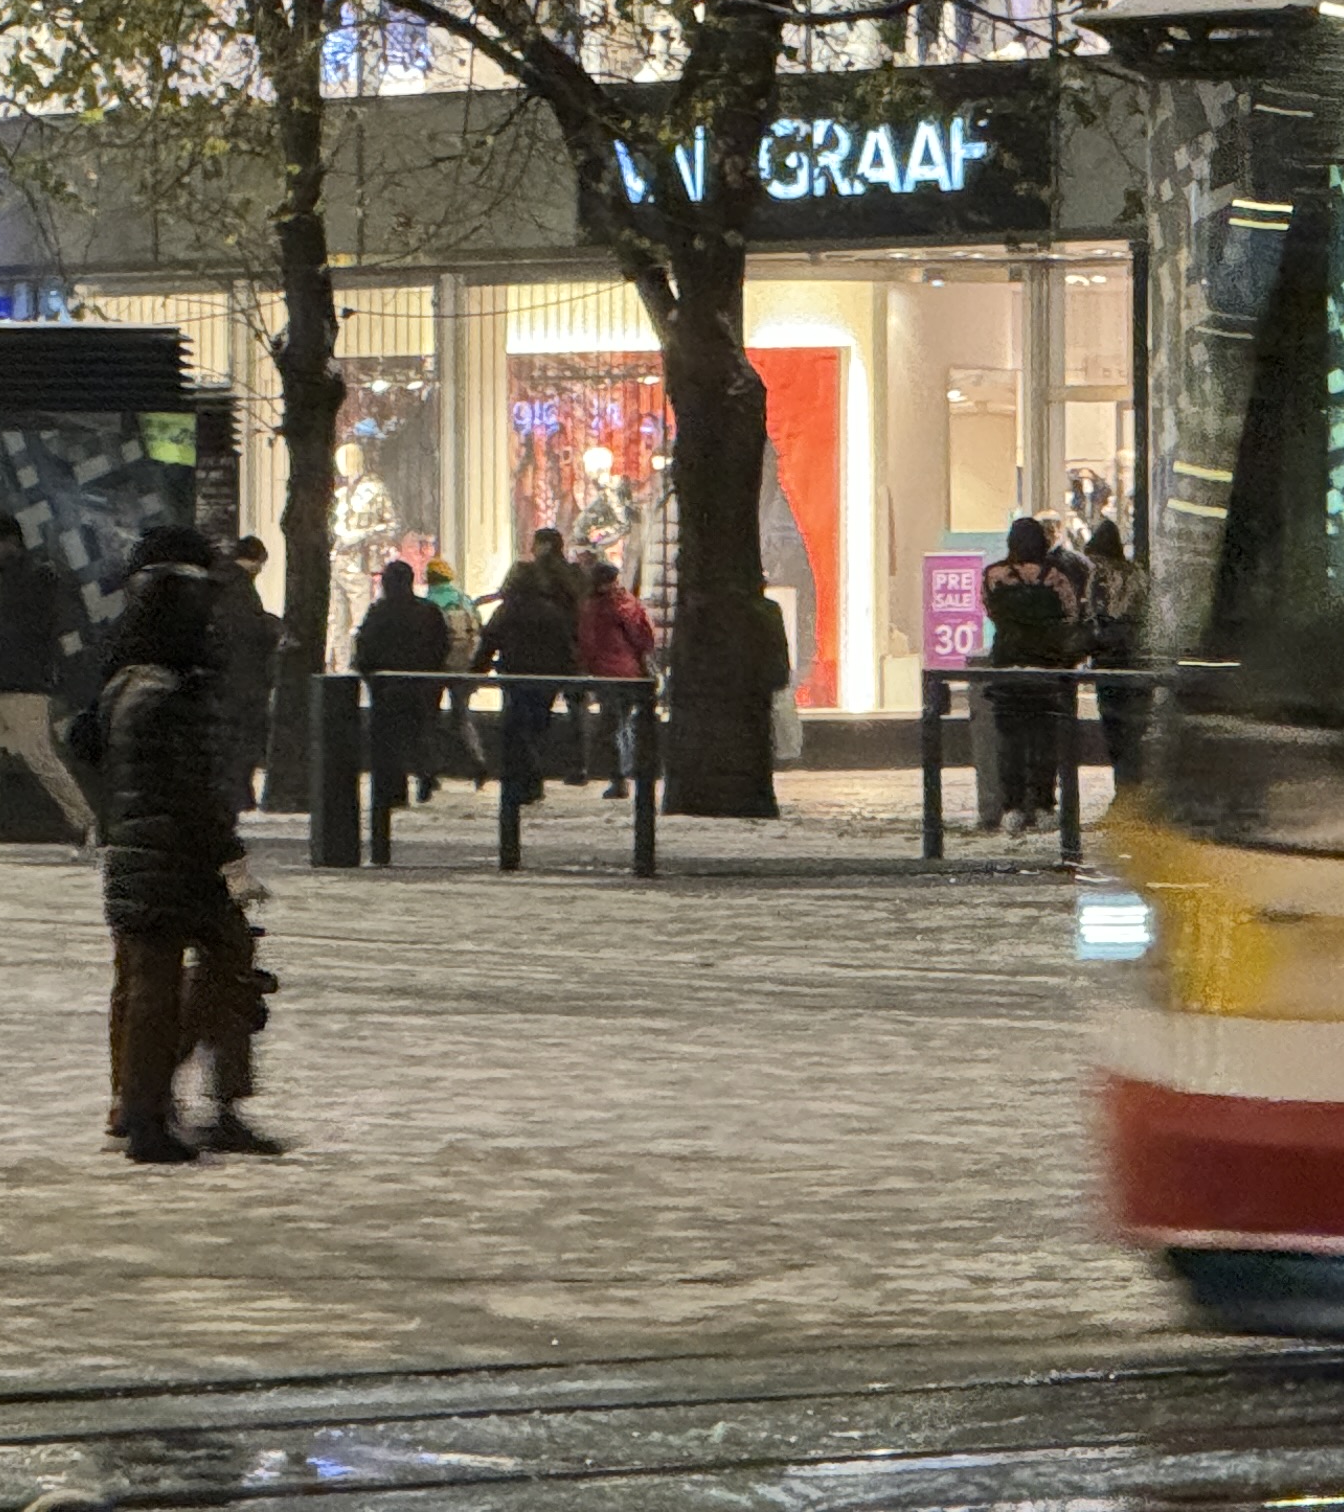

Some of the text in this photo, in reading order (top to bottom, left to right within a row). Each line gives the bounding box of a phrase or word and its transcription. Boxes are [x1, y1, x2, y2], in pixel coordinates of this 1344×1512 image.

[757, 116, 990, 199] GRAAF
[935, 572, 973, 591] PRE
[934, 592, 973, 610] SALE
